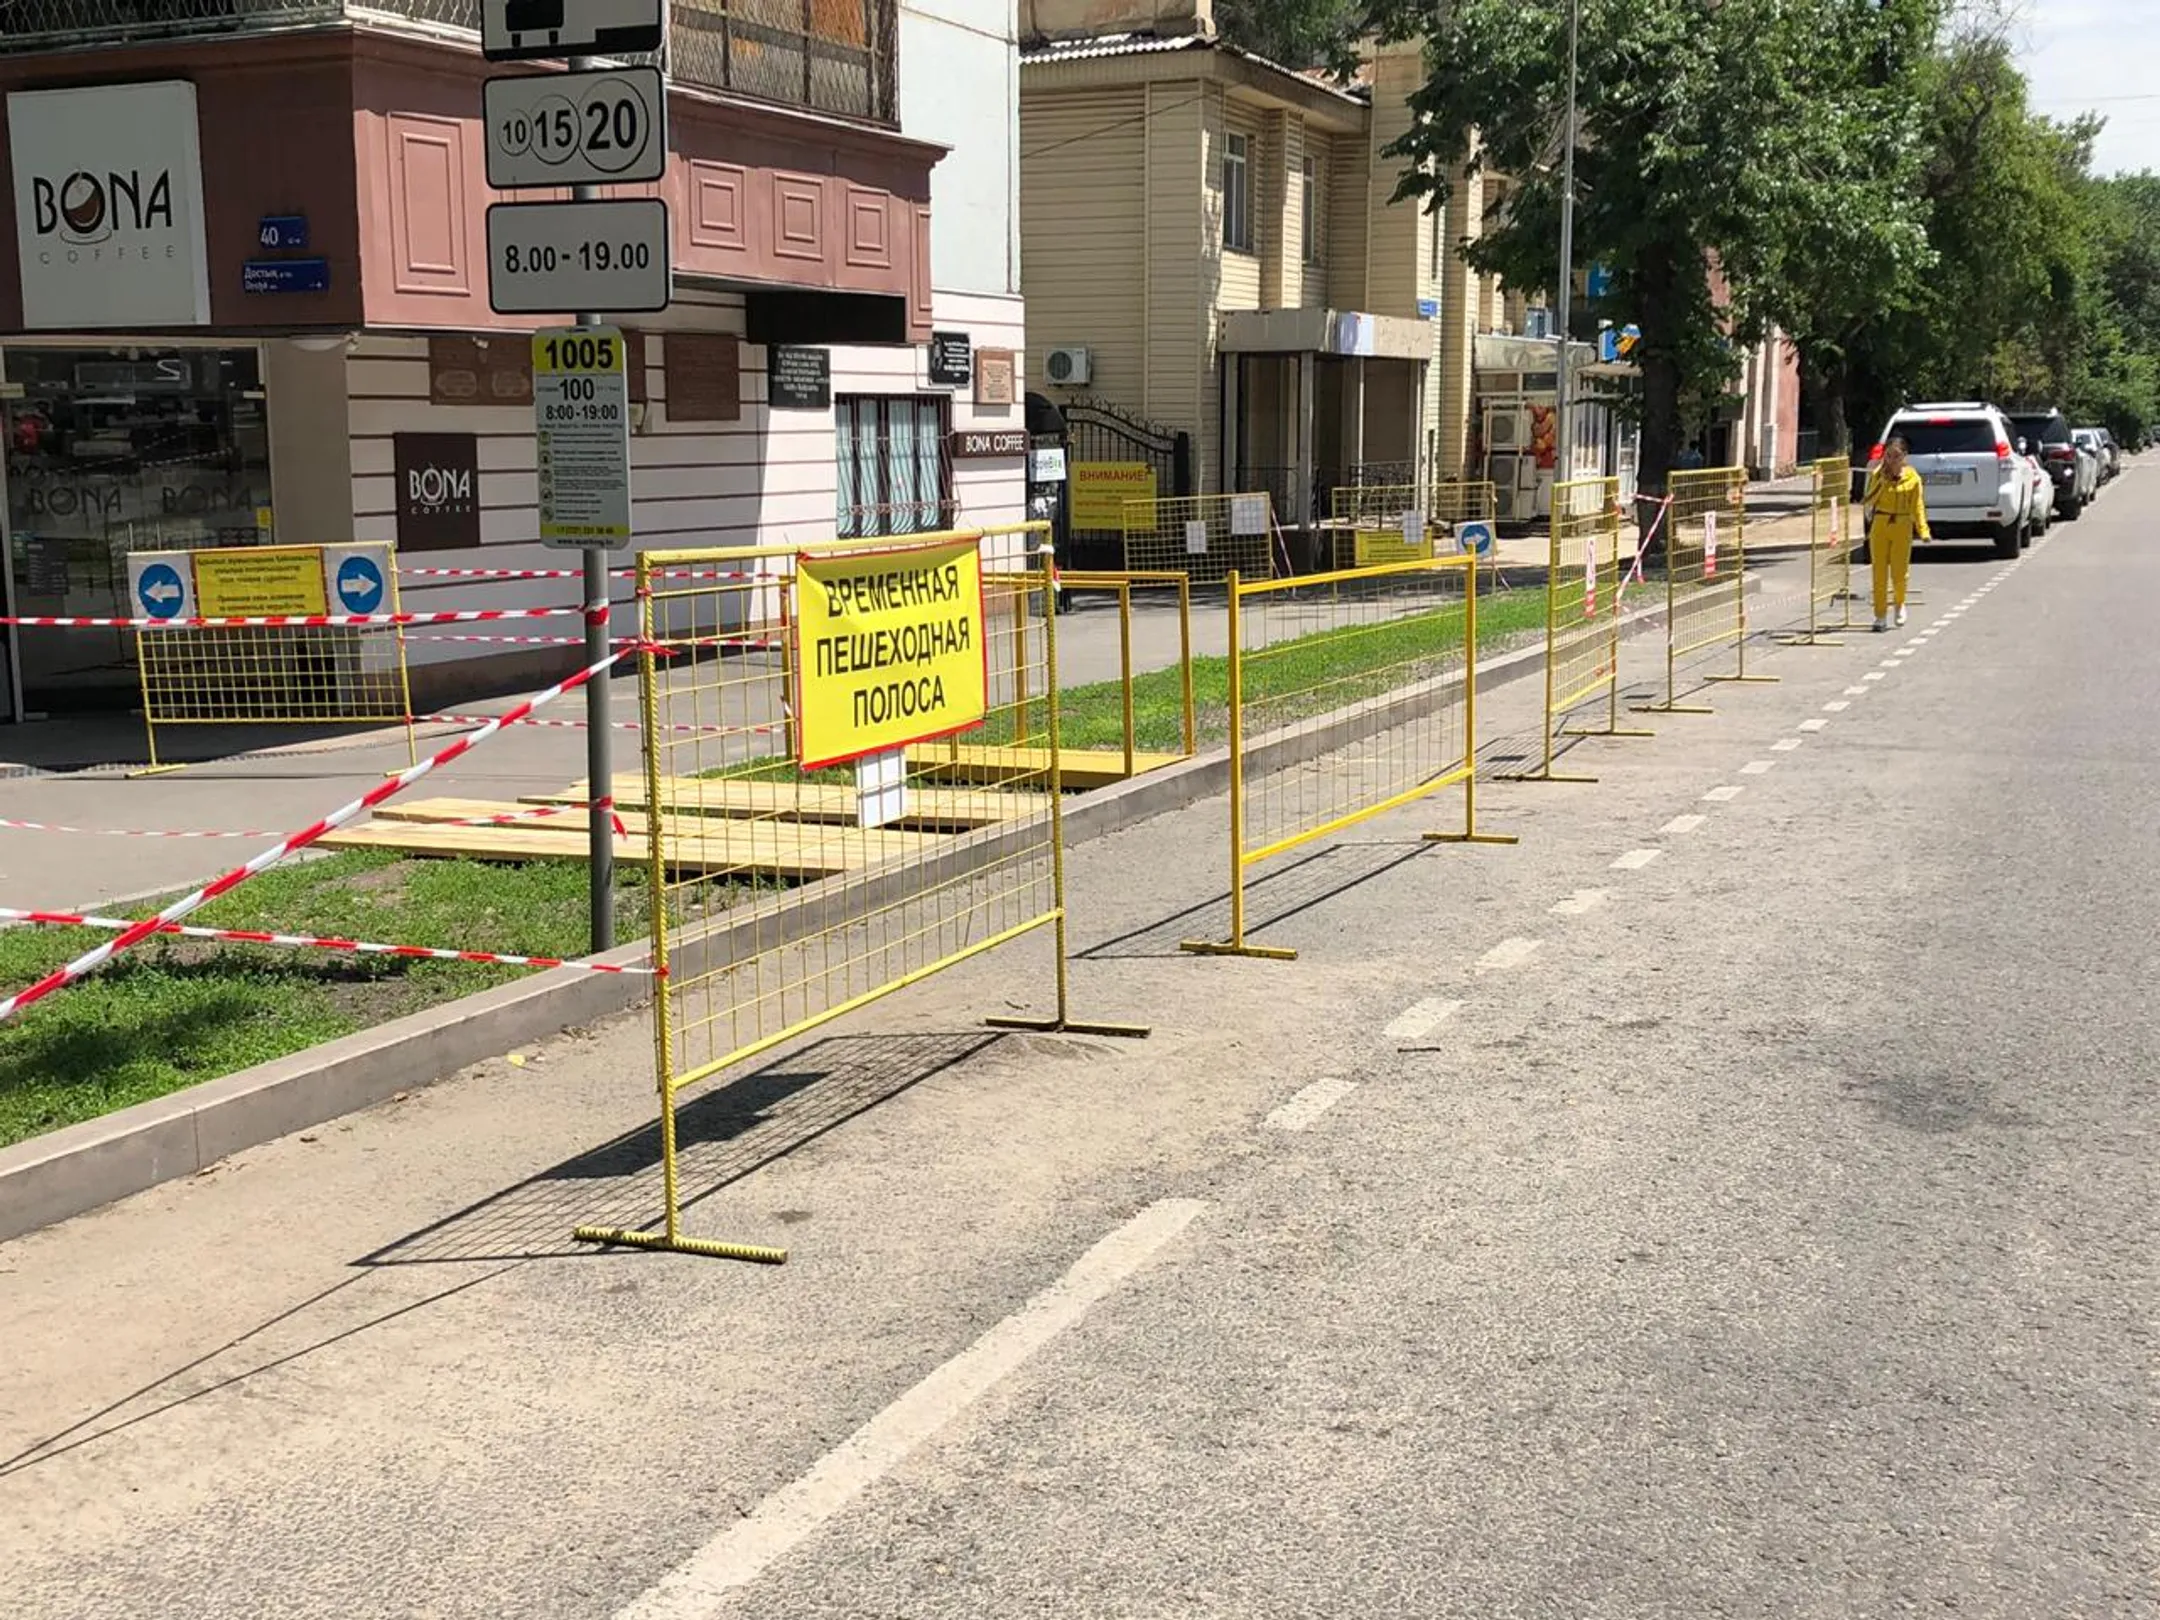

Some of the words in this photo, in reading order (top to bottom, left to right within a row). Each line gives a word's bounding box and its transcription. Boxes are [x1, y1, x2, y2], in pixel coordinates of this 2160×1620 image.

[502, 119, 527, 146] 10
[534, 109, 573, 149] 15
[585, 98, 638, 151] 20
[32, 169, 173, 235] BONA
[260, 226, 279, 246] 40
[38, 245, 176, 265] COFFEE
[544, 338, 614, 370] 1005
[559, 378, 595, 401] 100
[964, 434, 992, 453] BONA
[993, 434, 1025, 453] COFFEE
[408, 467, 471, 501] BONA
[411, 504, 471, 515] COFFEE
[823, 565, 960, 618] ВРЕМЕННАЯ
[816, 616, 971, 678] ПЕШЕХОДНАЯ
[853, 675, 946, 729] ПОЛОСА
